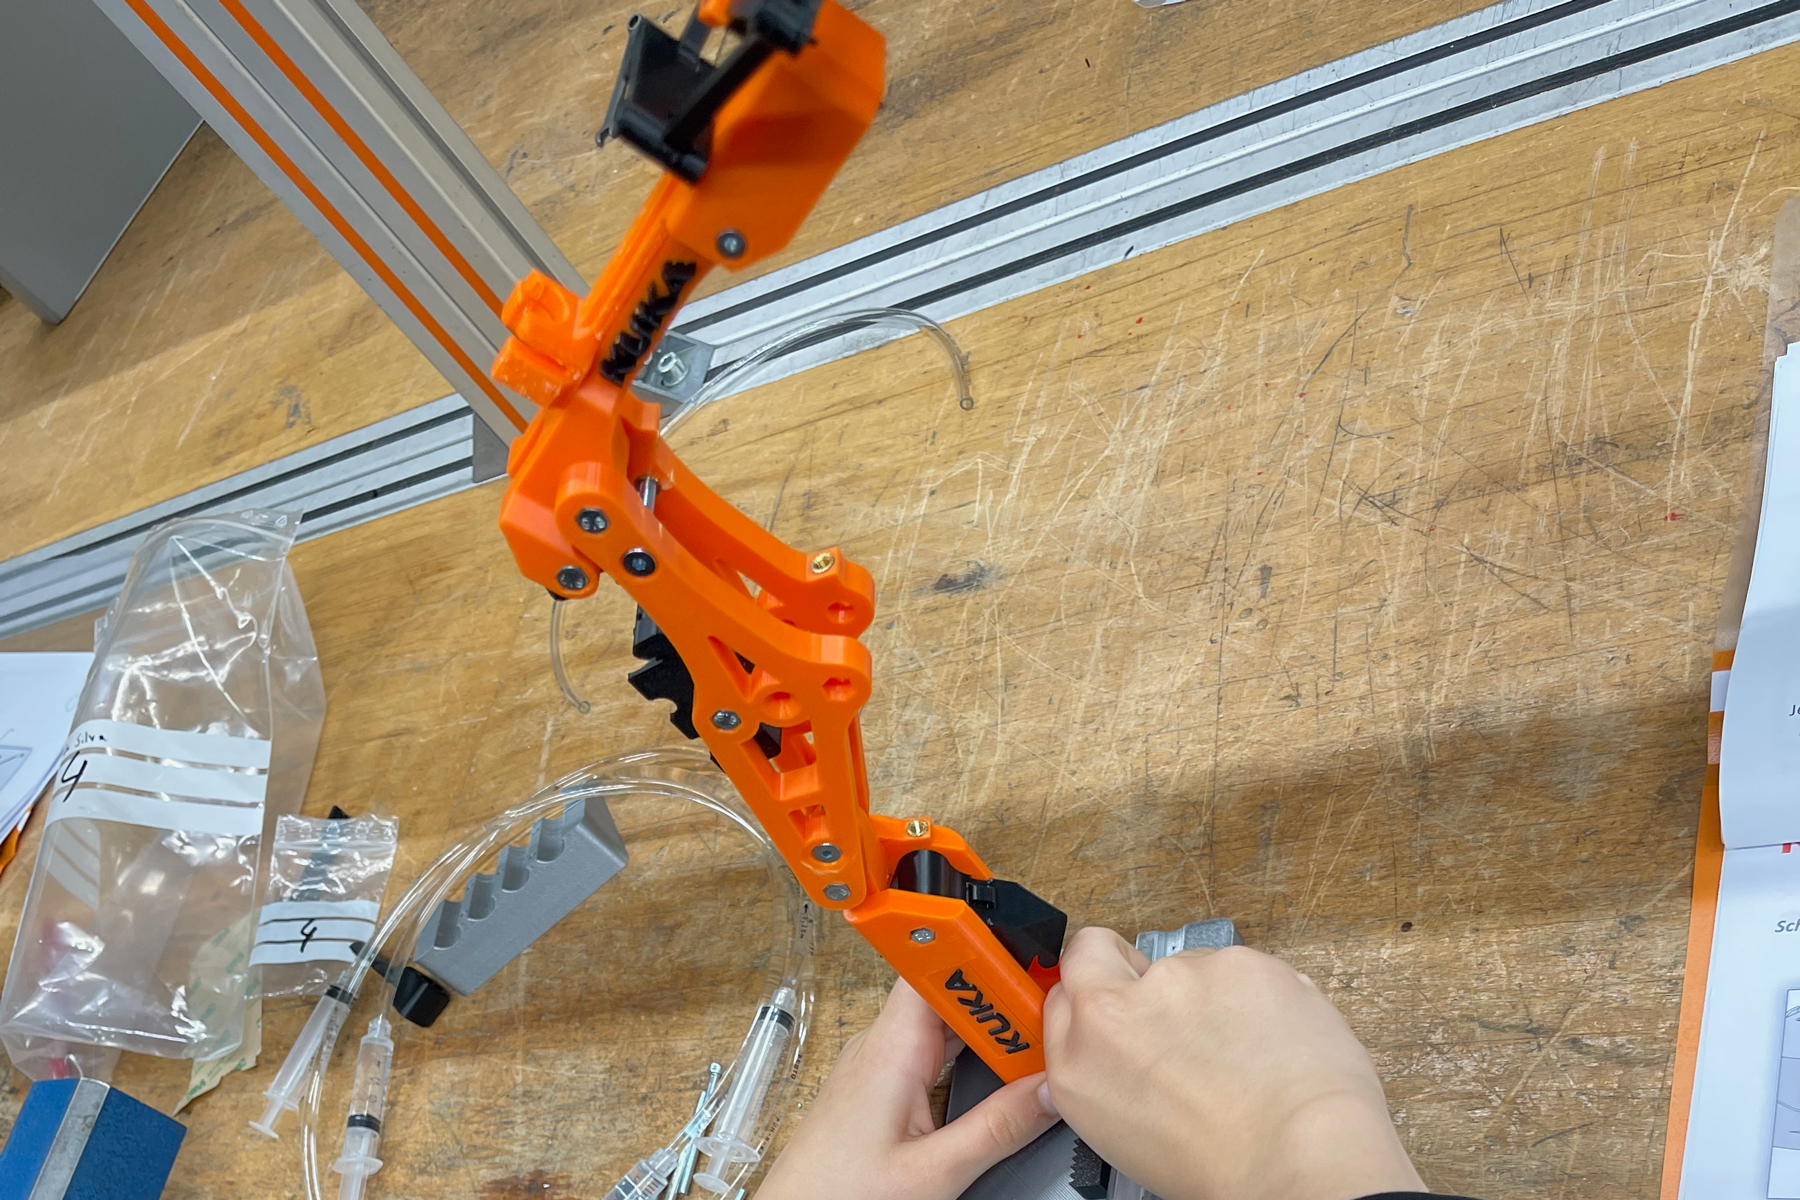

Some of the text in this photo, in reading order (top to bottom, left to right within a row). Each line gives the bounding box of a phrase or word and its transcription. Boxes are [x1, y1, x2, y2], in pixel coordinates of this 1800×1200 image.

[1788, 704, 1800, 717] J
[61, 751, 88, 803] 4
[300, 918, 318, 953] 4
[944, 968, 1030, 1055] KUKA
